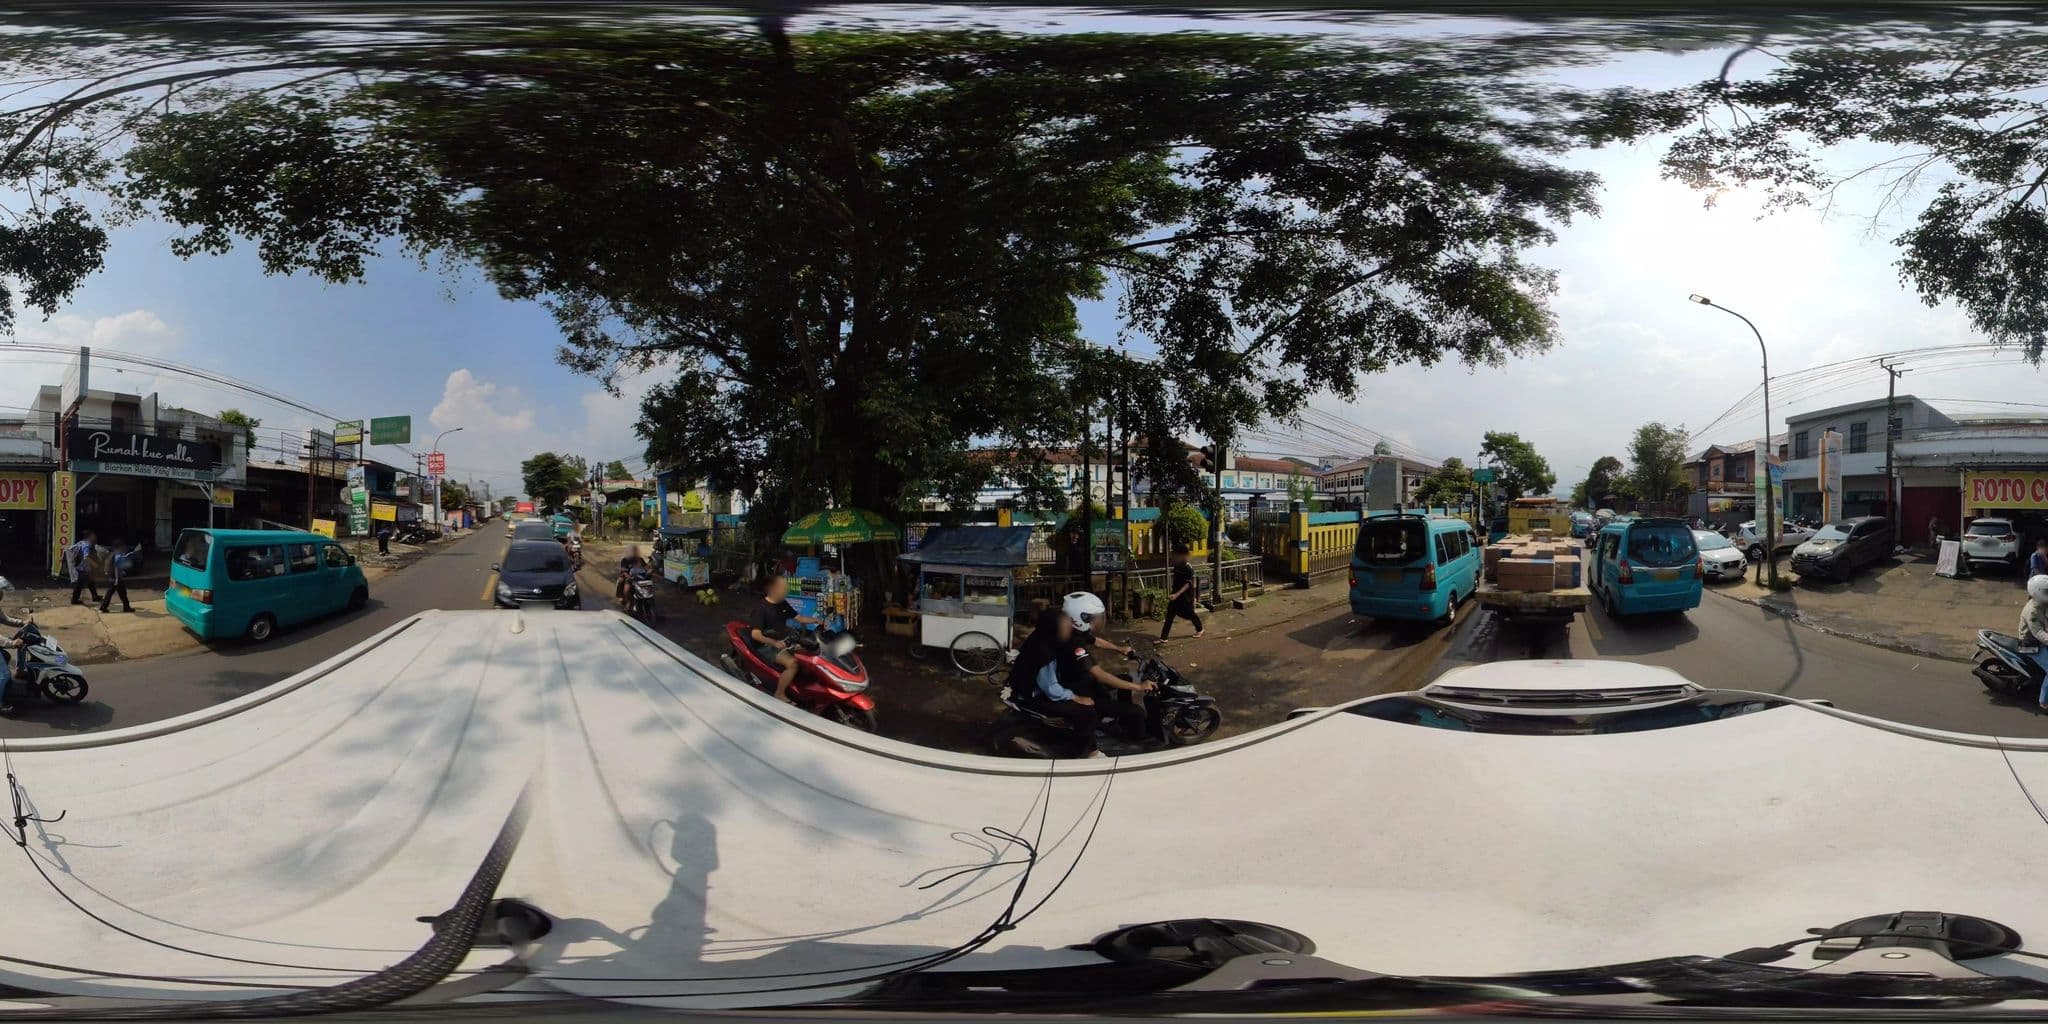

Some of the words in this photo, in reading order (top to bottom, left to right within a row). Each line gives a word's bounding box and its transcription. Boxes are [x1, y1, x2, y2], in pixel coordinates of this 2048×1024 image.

[88, 432, 140, 458] Rumah
[166, 443, 194, 463] milla
[1973, 478, 2025, 502] FOTO
